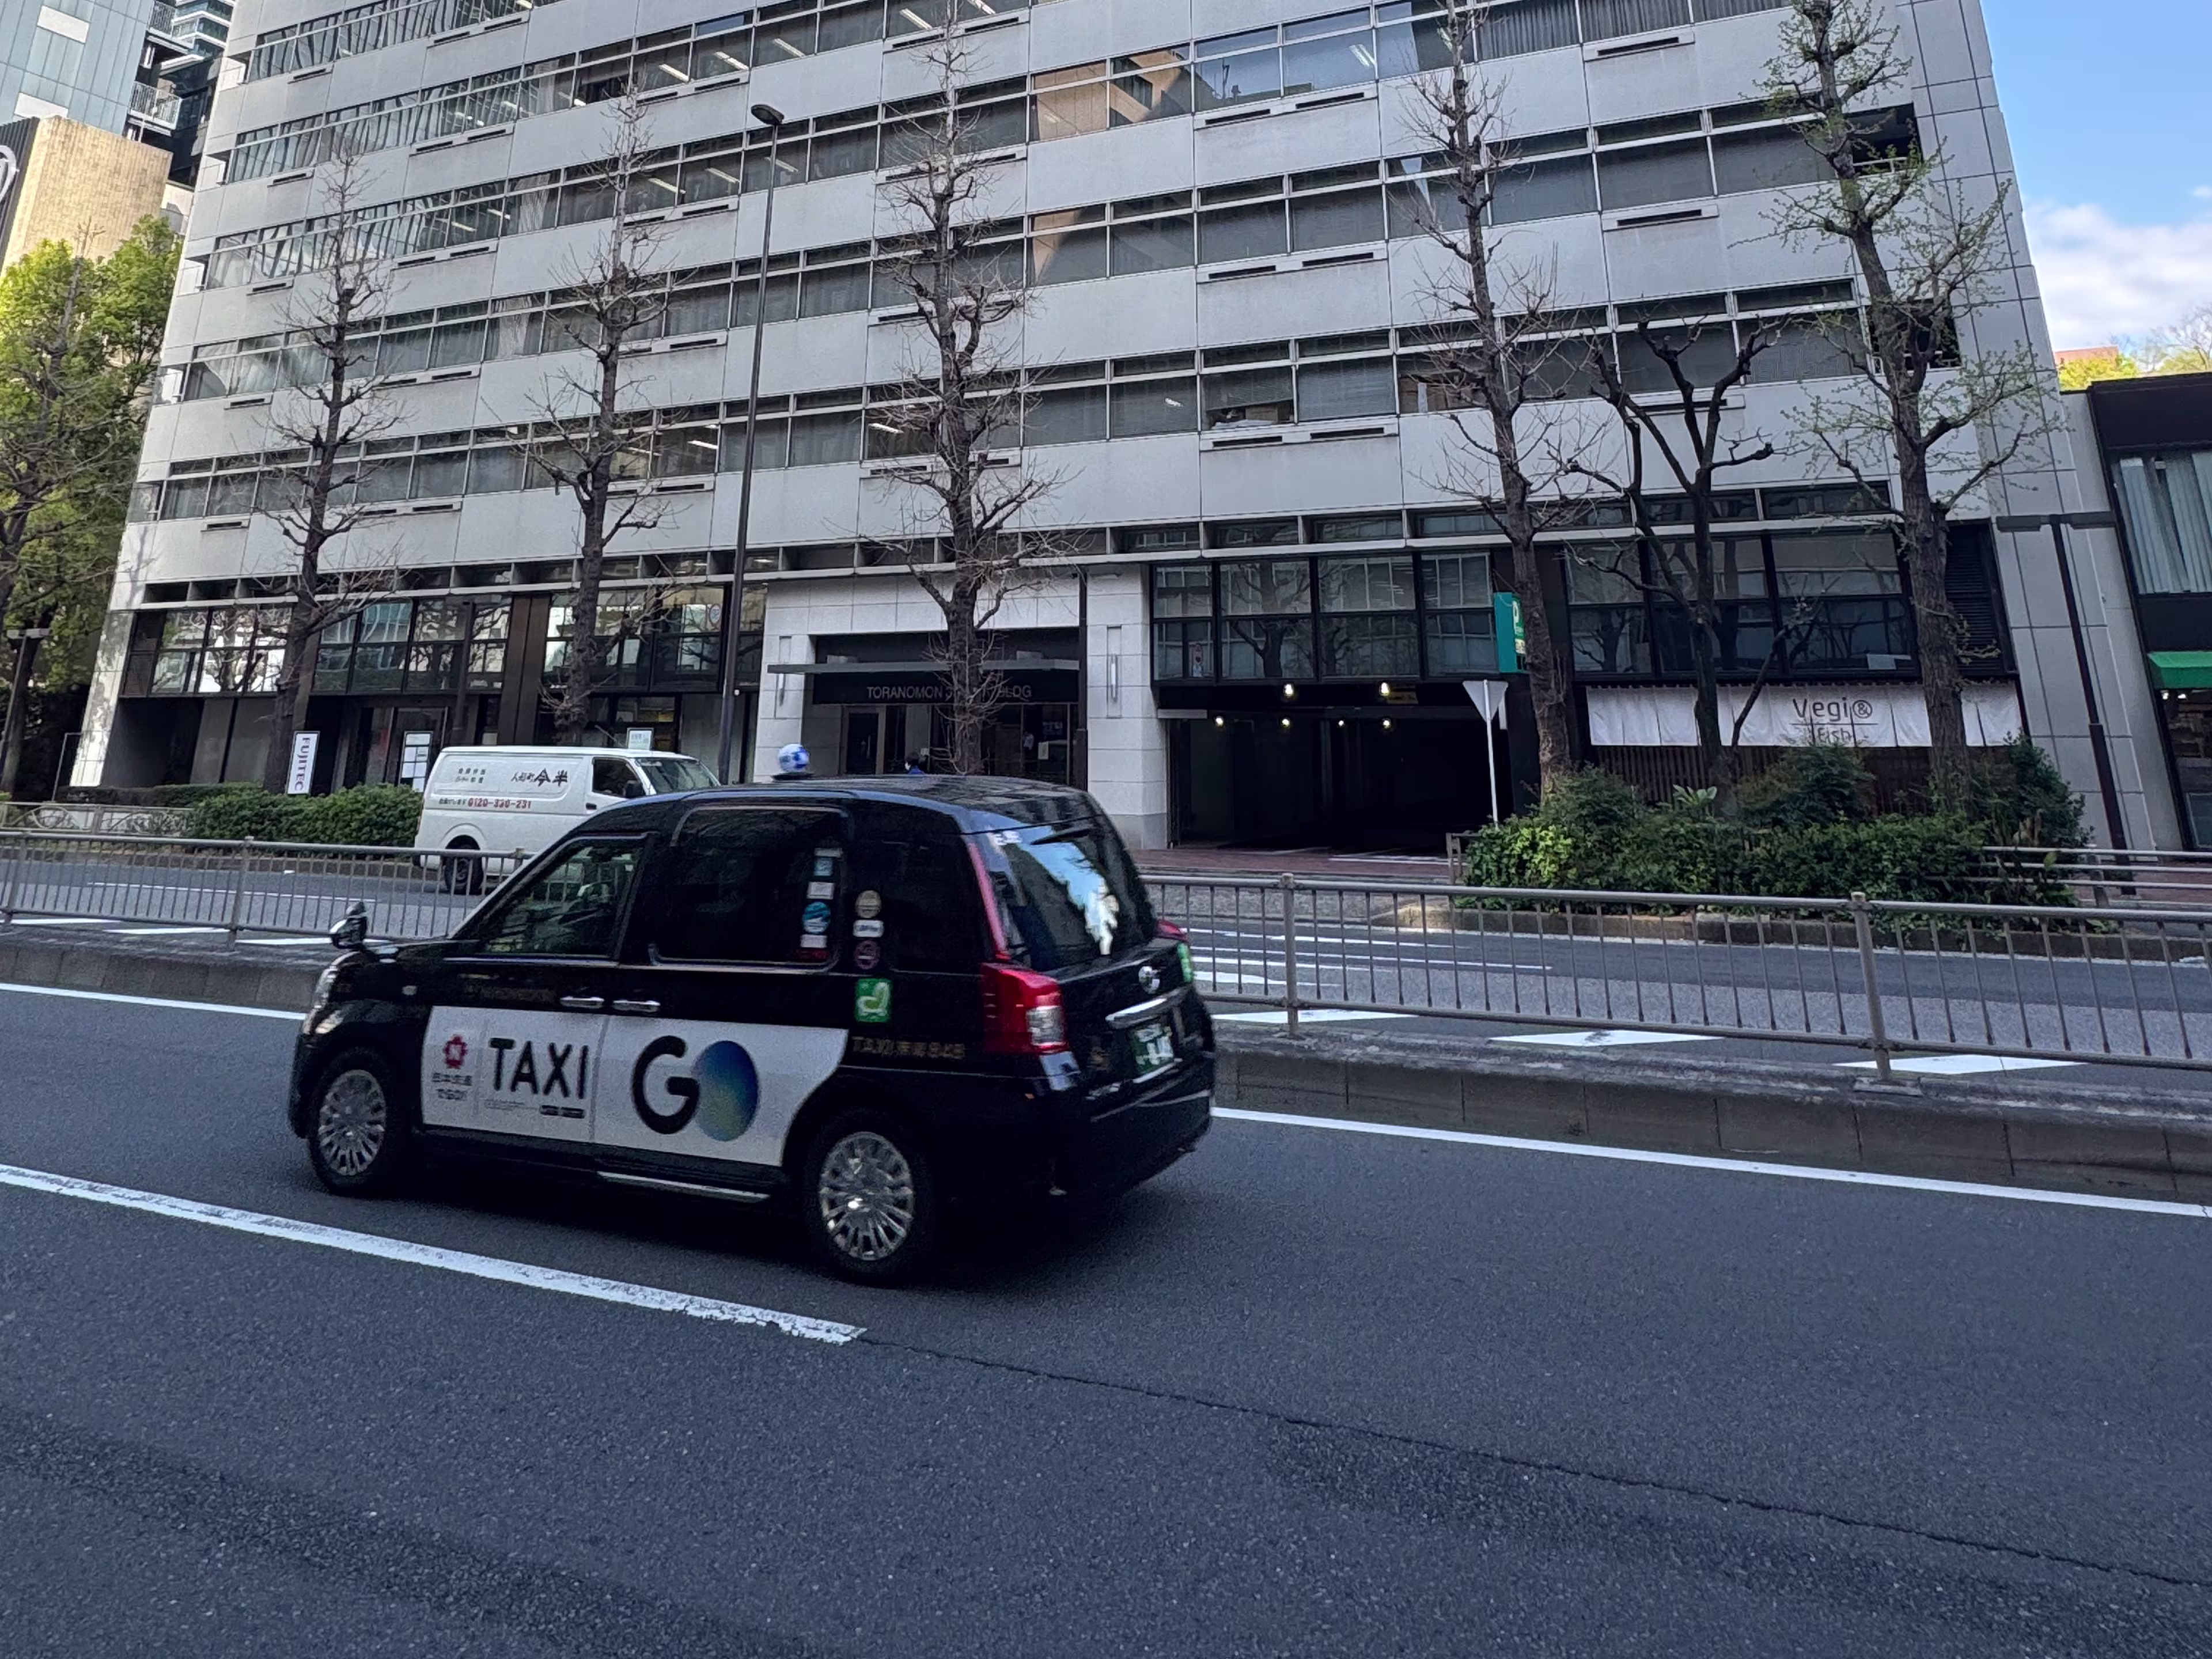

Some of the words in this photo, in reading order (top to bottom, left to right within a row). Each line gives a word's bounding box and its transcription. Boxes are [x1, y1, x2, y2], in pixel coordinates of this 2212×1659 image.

[866, 685, 942, 699] TORANOMON
[294, 737, 310, 791] FUJITEC
[489, 1037, 589, 1100] TAXI
